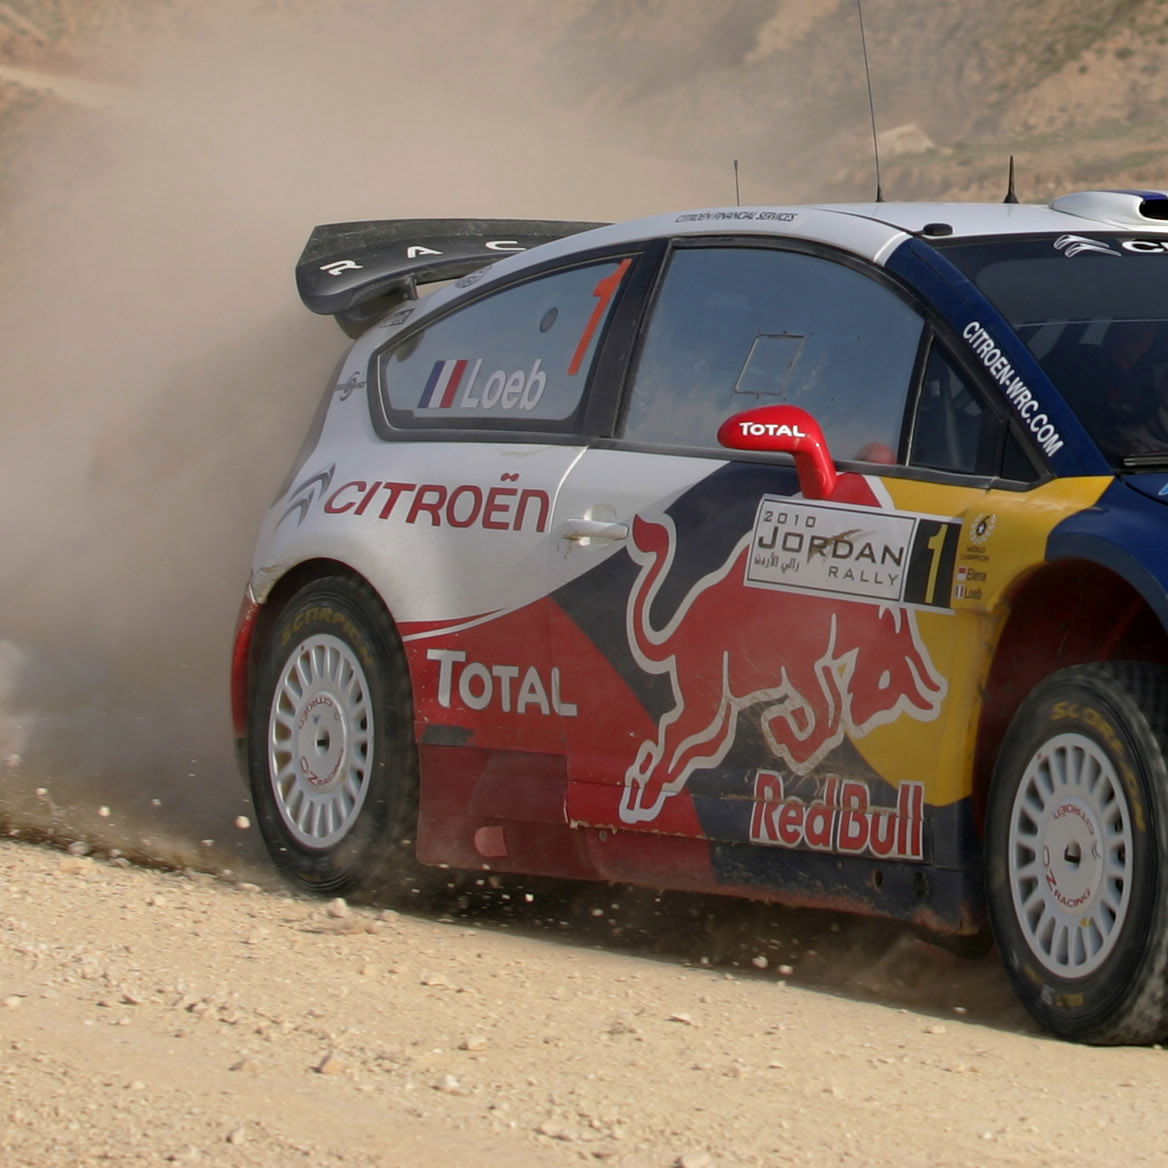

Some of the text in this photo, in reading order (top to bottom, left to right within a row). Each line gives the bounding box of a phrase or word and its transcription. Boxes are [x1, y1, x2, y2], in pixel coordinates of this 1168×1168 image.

[567, 257, 633, 376] 1
[459, 357, 548, 410] Loeb
[962, 320, 1064, 458] CITROEN-WRC.COM
[738, 420, 807, 438] TOTAL
[322, 472, 551, 534] CITROËN
[763, 510, 817, 529] 2010
[757, 525, 906, 568] JORDAN
[926, 523, 949, 604] 1
[827, 565, 900, 587] RALLY
[426, 648, 578, 717] TOTAL
